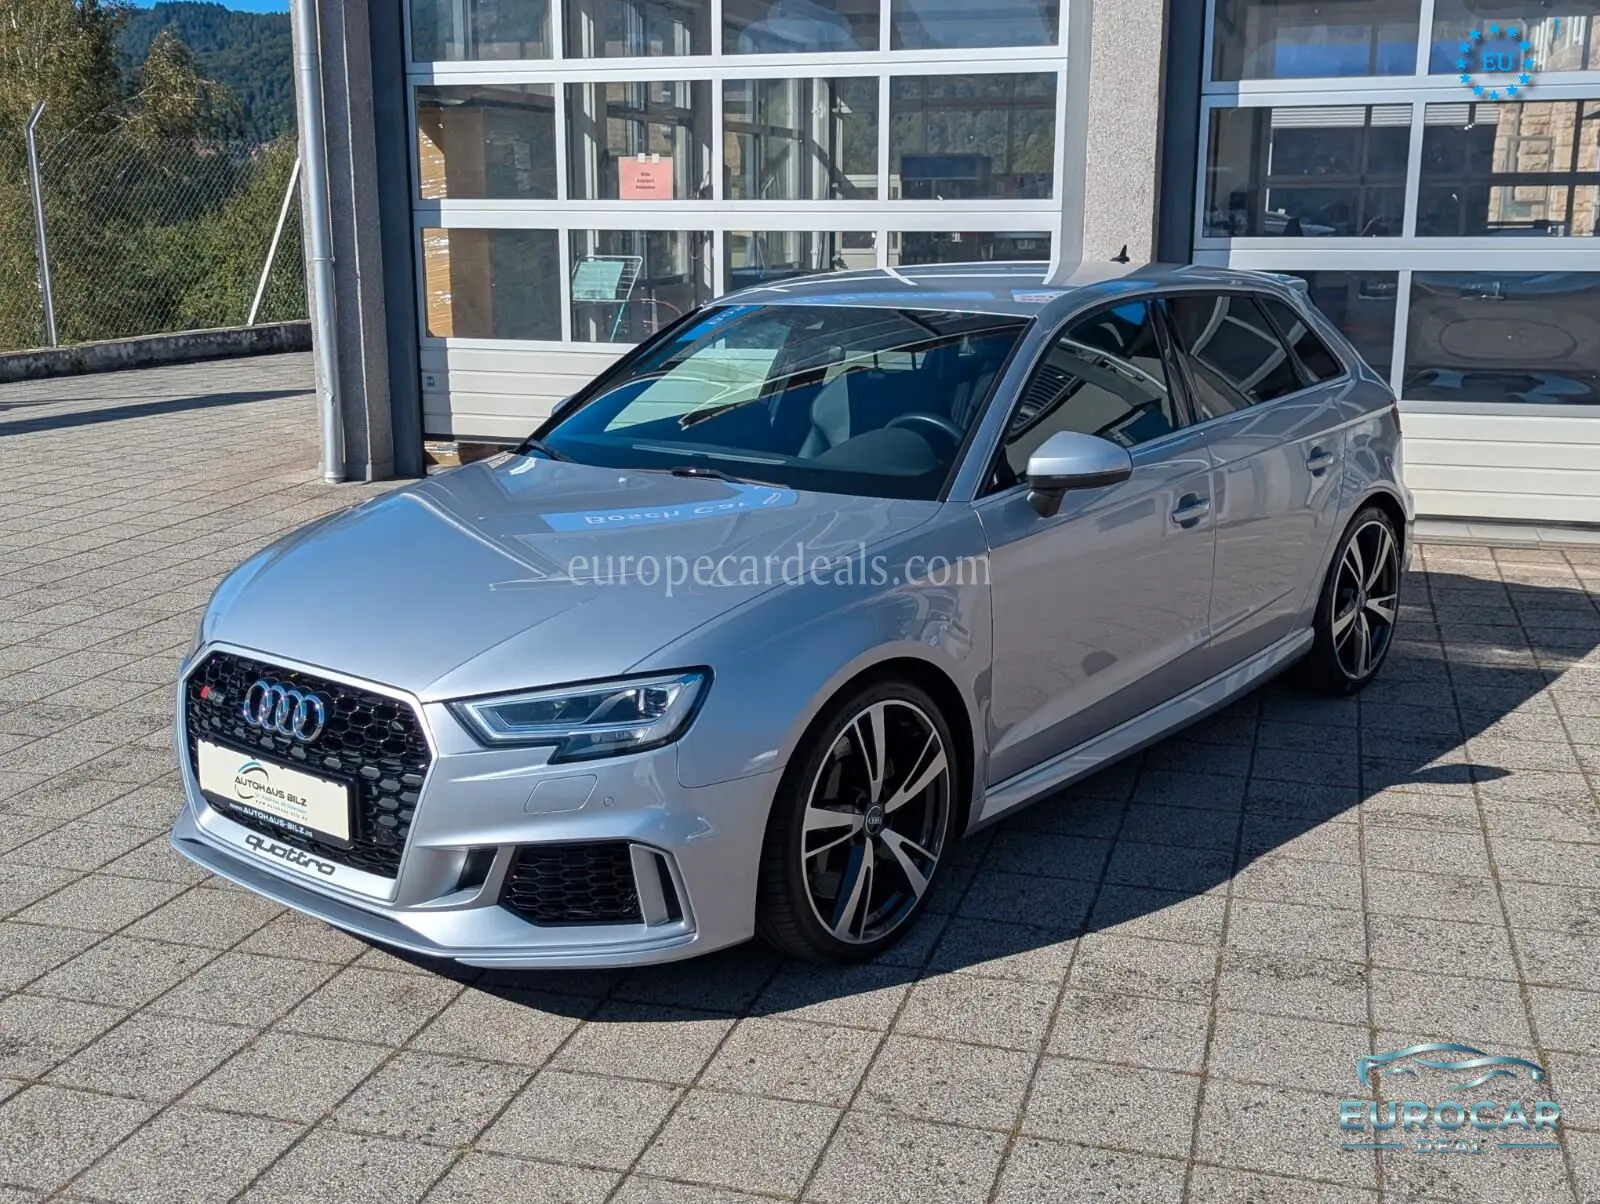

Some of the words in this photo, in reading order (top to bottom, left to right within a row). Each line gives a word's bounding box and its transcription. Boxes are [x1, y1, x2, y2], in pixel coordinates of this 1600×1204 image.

[234, 775, 285, 799] AUTOHAUS
[286, 793, 308, 807] BILZ
[245, 834, 336, 876] quattro
